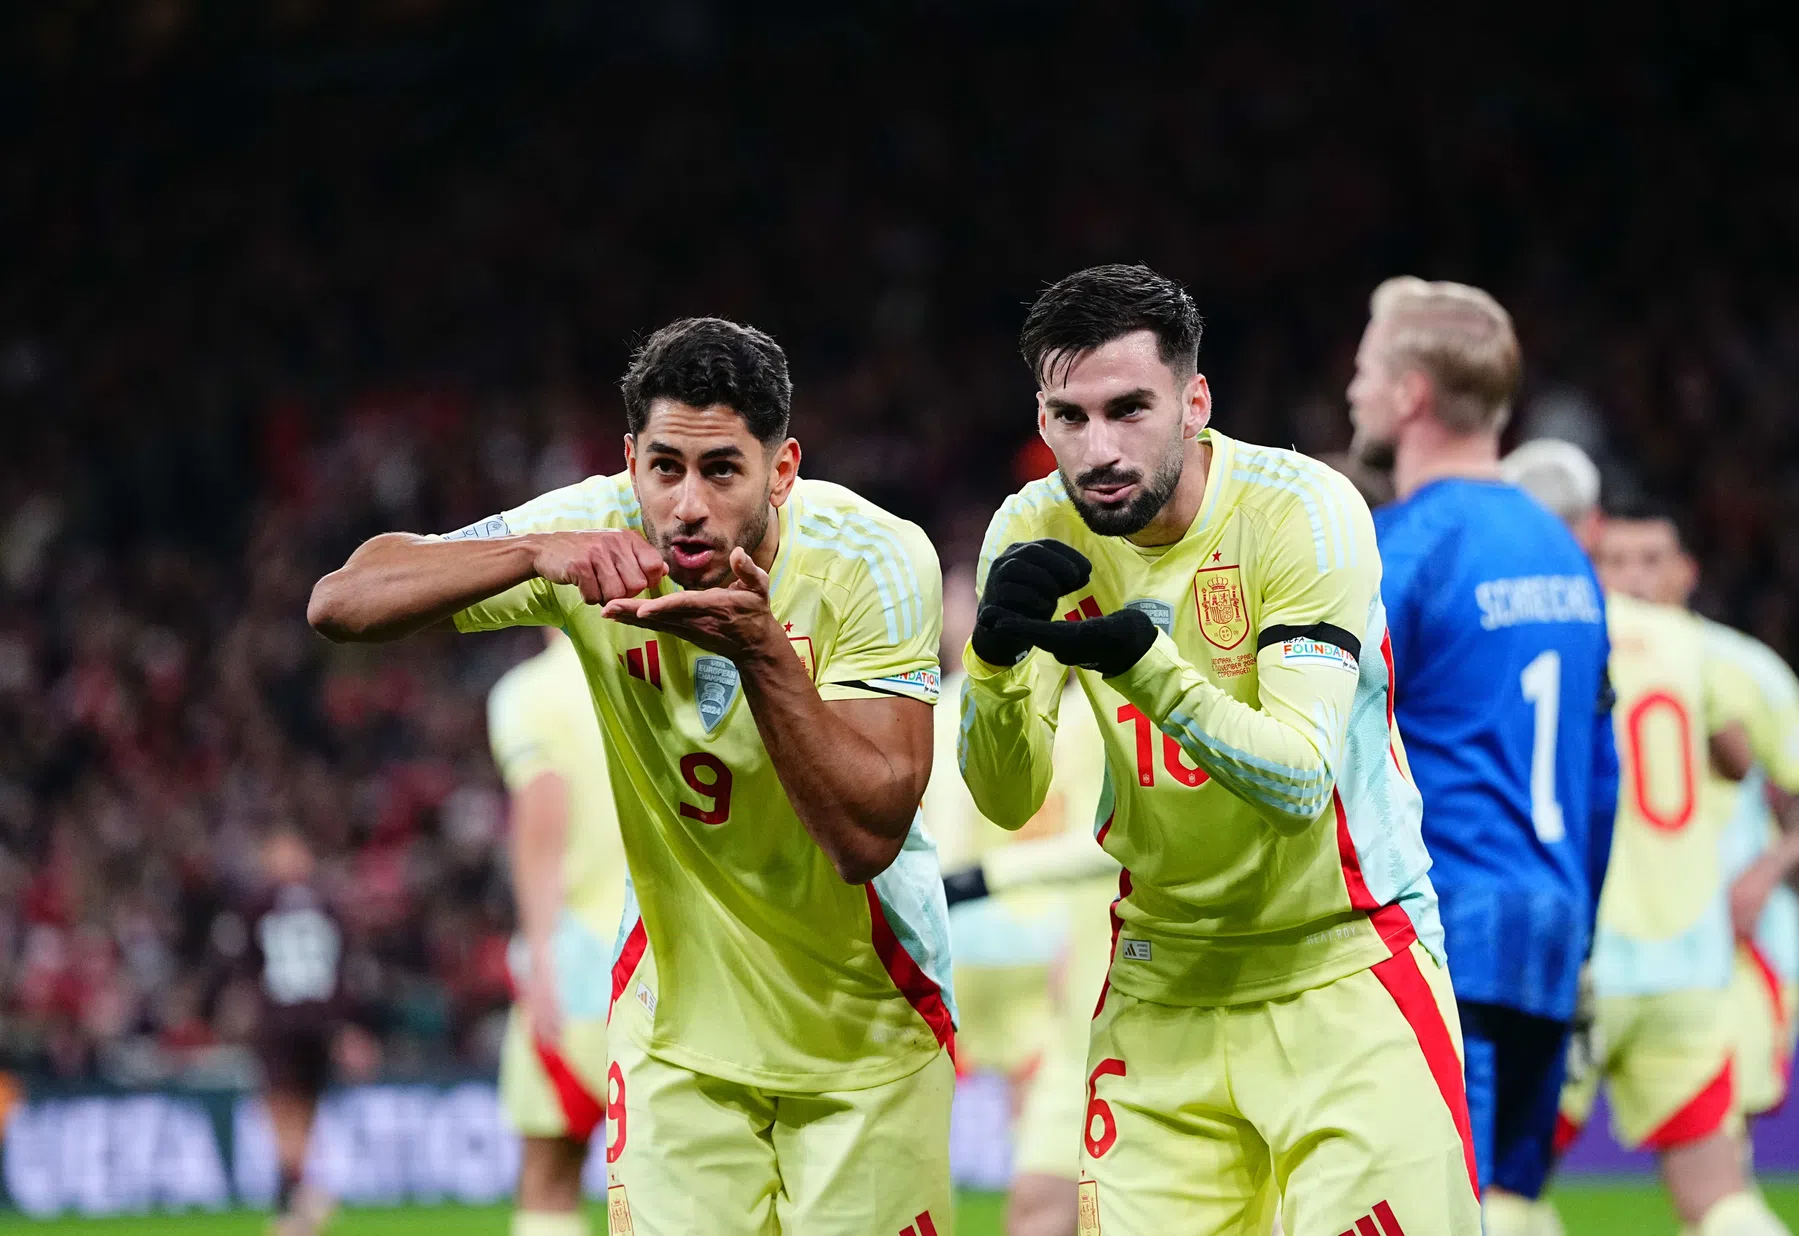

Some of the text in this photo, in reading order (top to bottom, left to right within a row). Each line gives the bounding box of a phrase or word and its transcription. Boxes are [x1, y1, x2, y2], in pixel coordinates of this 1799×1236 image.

[1143, 609, 1169, 617] OPEAN
[1284, 643, 1355, 662] FOUNDATI
[698, 664, 737, 679] EUROPEAN
[698, 672, 736, 686] CHAMPIONS
[701, 704, 722, 716] 2024
[1519, 649, 1565, 843] 1
[680, 752, 733, 825] 9
[607, 1060, 627, 1163] 9
[1084, 1058, 1127, 1159] 6
